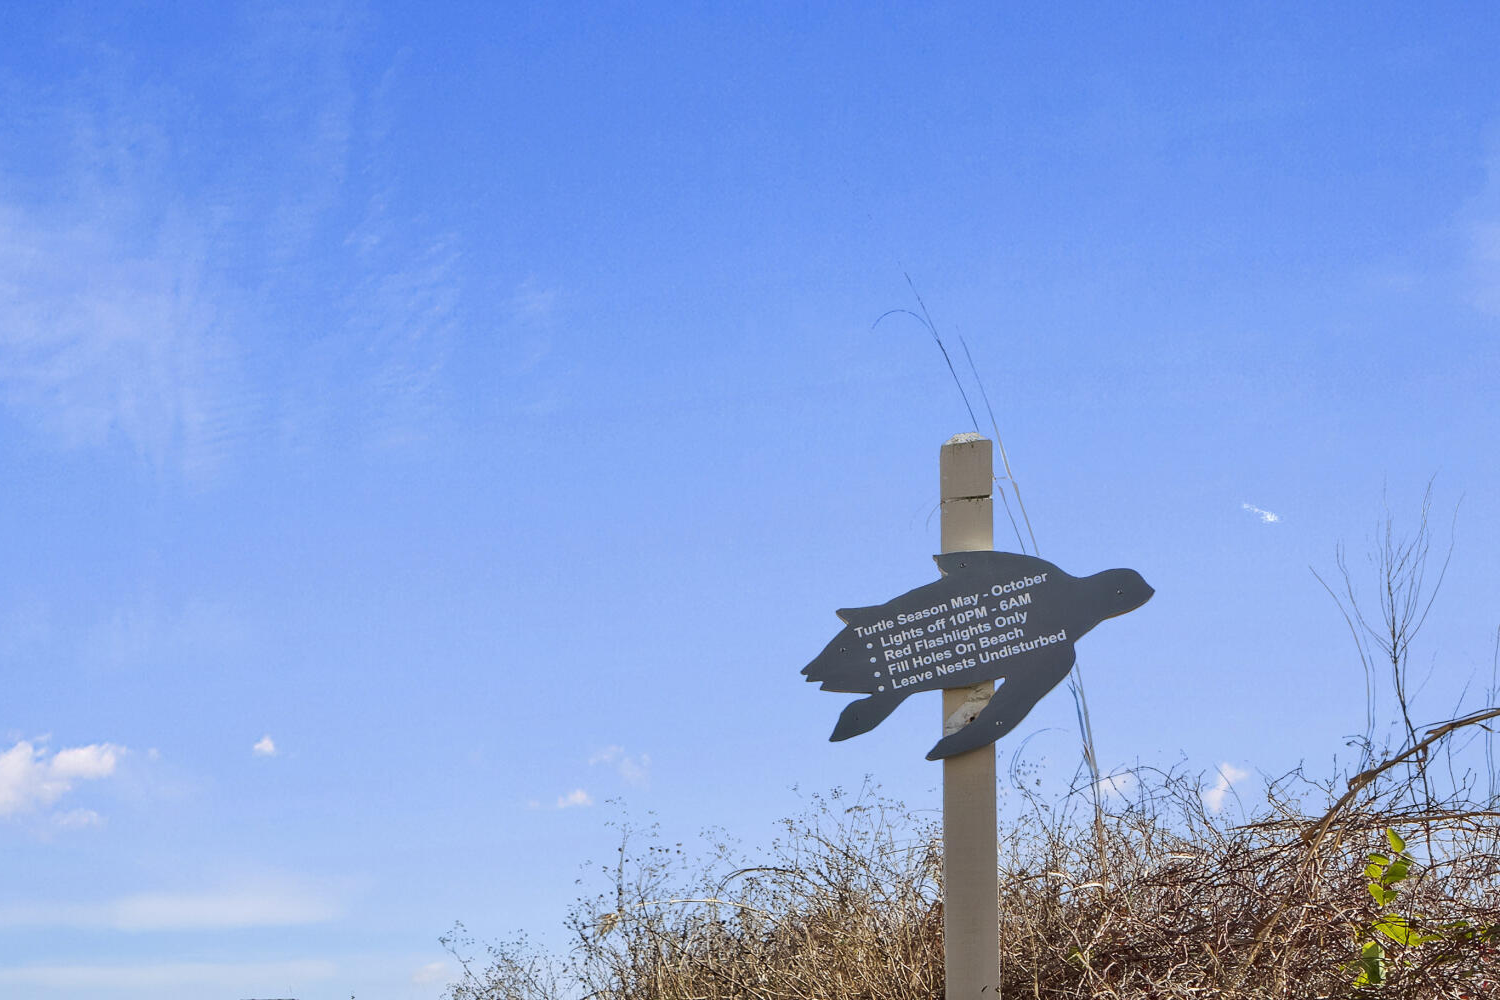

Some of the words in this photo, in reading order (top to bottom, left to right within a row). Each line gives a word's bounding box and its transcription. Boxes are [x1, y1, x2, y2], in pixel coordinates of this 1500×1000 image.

[854, 620, 895, 638] Turtle
[897, 603, 948, 625] Season
[950, 594, 979, 609] May
[991, 573, 1048, 597] October
[880, 627, 924, 647] Lights
[927, 618, 946, 633] off
[949, 606, 988, 626] 10PM
[999, 593, 1032, 611] 6AM
[884, 644, 913, 661] Red
[915, 622, 992, 653] Flashlights
[995, 611, 1028, 628] Only
[888, 659, 910, 675] Fill
[912, 649, 953, 668] Holes
[955, 642, 977, 655] On
[979, 627, 1024, 649] Beach
[892, 671, 933, 689] Leave
[936, 657, 977, 676] Nests
[979, 629, 1067, 663] Undisturbed
